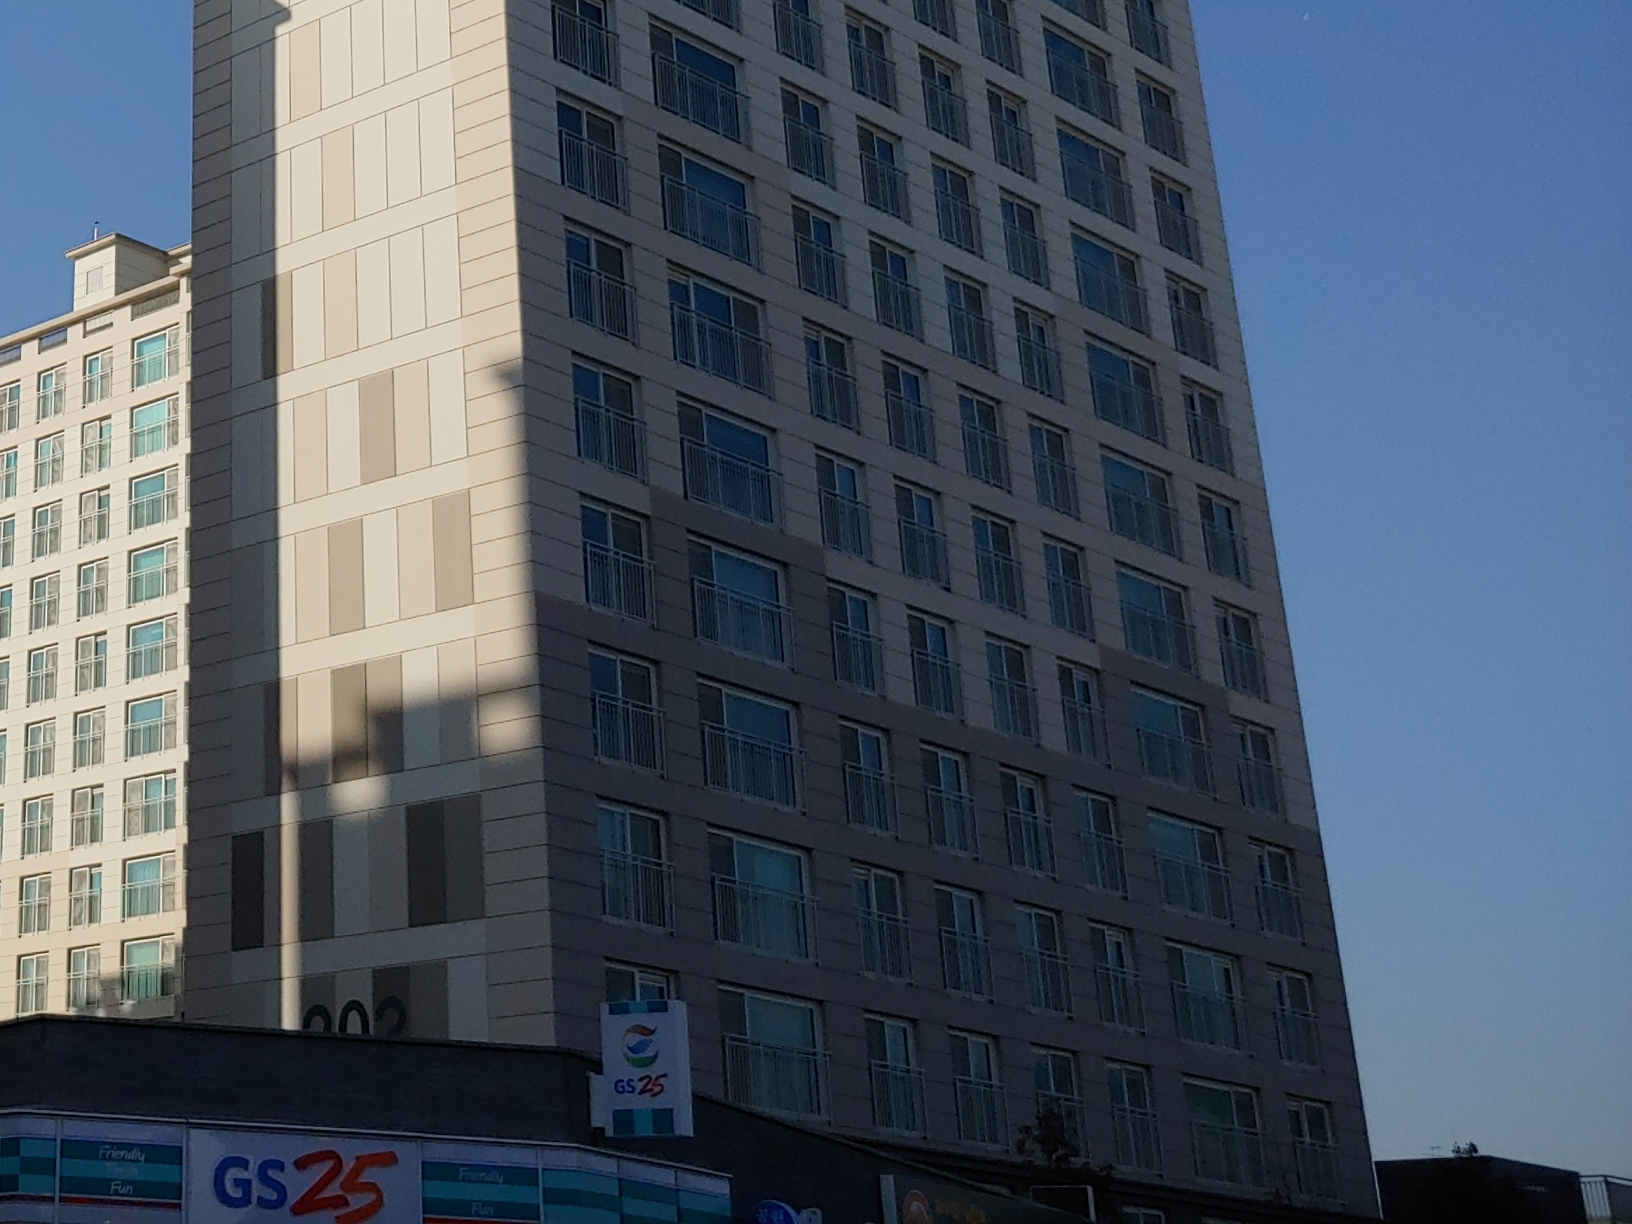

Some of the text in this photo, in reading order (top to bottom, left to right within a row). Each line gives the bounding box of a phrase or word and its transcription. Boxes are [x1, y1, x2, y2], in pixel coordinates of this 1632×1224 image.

[98, 1144, 146, 1164] Friendly
[109, 1179, 134, 1196] Fun
[470, 1201, 495, 1217] Fun
